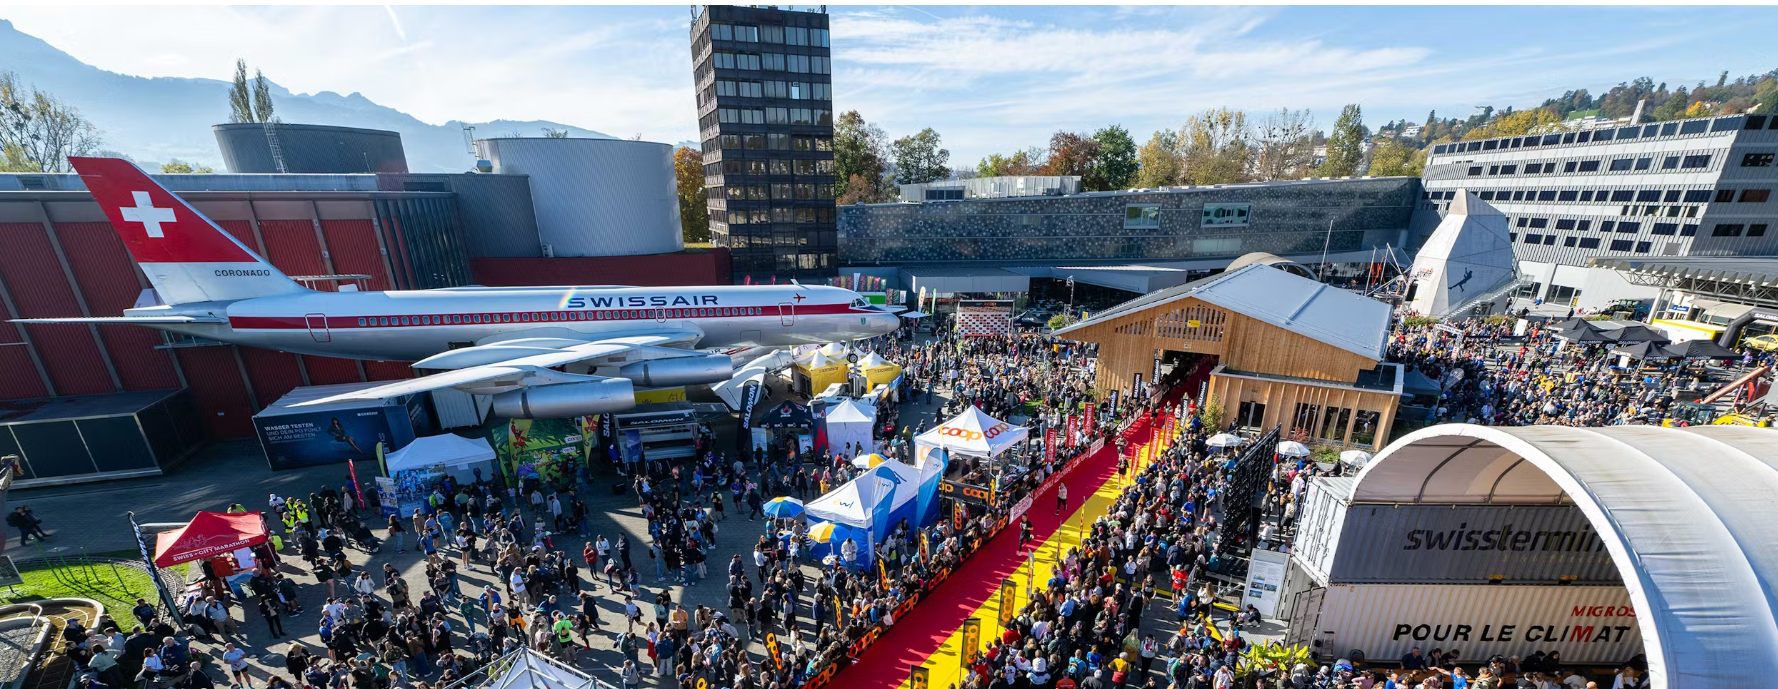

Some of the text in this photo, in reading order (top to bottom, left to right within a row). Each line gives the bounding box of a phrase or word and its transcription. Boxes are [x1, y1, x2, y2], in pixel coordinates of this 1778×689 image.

[214, 269, 271, 277] CORONADO
[567, 295, 719, 308] SWISSAIR
[630, 417, 684, 425] SALOMON
[743, 384, 756, 429] SALOMON
[938, 426, 982, 441] coop
[983, 422, 1010, 439] coop
[954, 502, 963, 530] coop
[172, 553, 194, 562] SWISS
[199, 547, 213, 556] CITY
[214, 538, 250, 552] MARATHON
[920, 532, 929, 564] coop
[878, 558, 889, 591] coop
[834, 594, 842, 630] coop
[892, 592, 919, 623] coop
[1001, 586, 1015, 622] coop
[848, 626, 882, 658] coop
[965, 624, 979, 664] coop
[1392, 624, 1631, 643] POUR LE CLIMAT
[766, 632, 783, 670] coop
